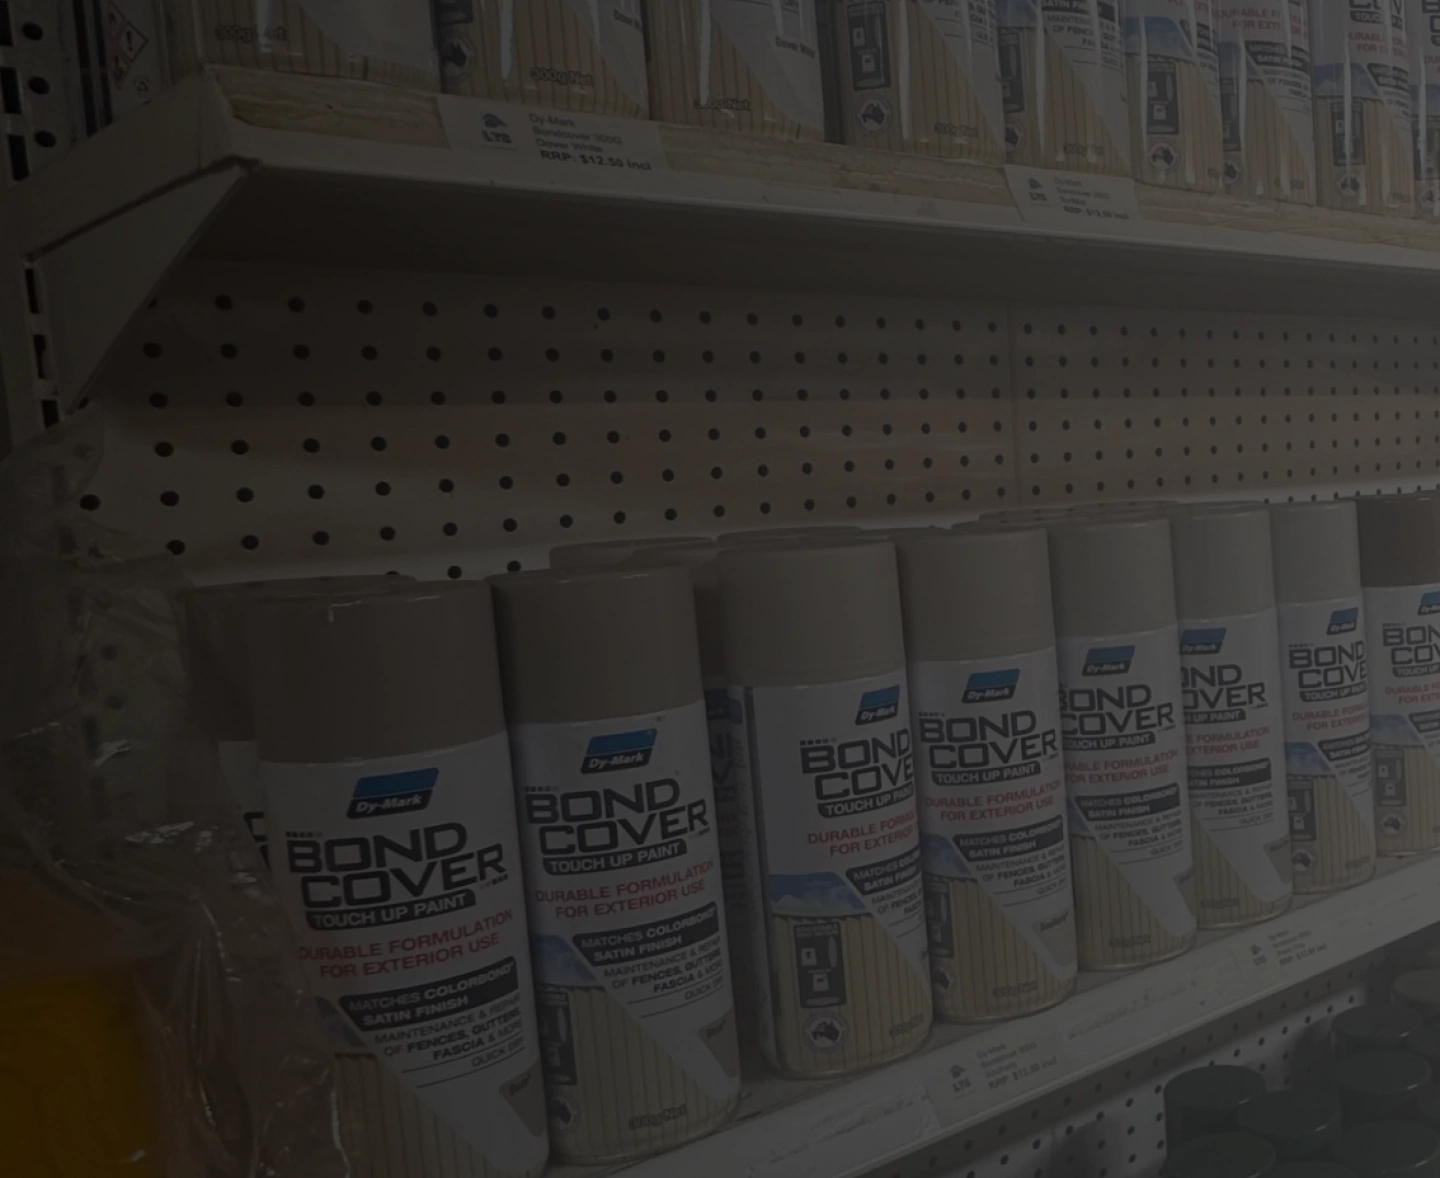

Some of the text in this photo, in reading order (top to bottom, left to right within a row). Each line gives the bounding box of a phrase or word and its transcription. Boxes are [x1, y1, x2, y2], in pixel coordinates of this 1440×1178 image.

[1288, 640, 1365, 670] BOND
[1181, 663, 1243, 689] ND
[1298, 662, 1367, 689] COVE
[968, 688, 1009, 699] Dy-Mark
[1182, 682, 1268, 711] OVER
[1305, 689, 1338, 701] TOUCH
[1398, 693, 1417, 704] FOR
[920, 710, 1036, 743] BOND
[1061, 702, 1176, 736] COVER
[1211, 710, 1241, 721] PAINT
[1292, 707, 1338, 721] DURABLE
[1307, 720, 1327, 731] FOR
[800, 728, 910, 775] BOND
[929, 728, 1058, 769] COVER
[1065, 734, 1150, 750] OUCH UP PAINT
[588, 751, 644, 769] Dy-Mark
[937, 763, 1036, 783] TOUCH UP PAINT
[815, 753, 913, 801] COVE
[1089, 764, 1169, 783] EXTERIOR USE
[356, 793, 422, 814] Dy-Mark
[524, 778, 680, 824] BOND
[825, 799, 873, 816] TOUCH
[876, 794, 890, 806] UP
[924, 795, 983, 808] DURABLE
[940, 808, 966, 821] FOR
[970, 801, 1033, 820] EXTERIOR
[539, 798, 710, 855] COVER
[807, 823, 877, 844] DURABLE
[286, 822, 467, 873] BOND
[550, 842, 680, 873] TOUCH UP PAINT
[829, 842, 860, 856] FOR
[301, 843, 507, 908] COVER
[535, 859, 714, 903] DURABLE FORMULATION
[314, 893, 467, 928] TOUCH UP PAINT
[555, 879, 705, 919] FOR EXTERIOR USE
[298, 908, 513, 960] DURABLE FORMULATION
[581, 930, 643, 948] MATCHES
[320, 932, 500, 978] FOR EXTERIOR USE
[593, 935, 682, 962] SATIN FINISH
[653, 973, 695, 993] FASCIA
[350, 991, 421, 1011] MATCHES
[363, 995, 468, 1026] SATIN FINISH
[374, 1014, 476, 1044] MAINTENANCE
[384, 1045, 403, 1056] OF
[433, 1037, 485, 1060] FASCIA
